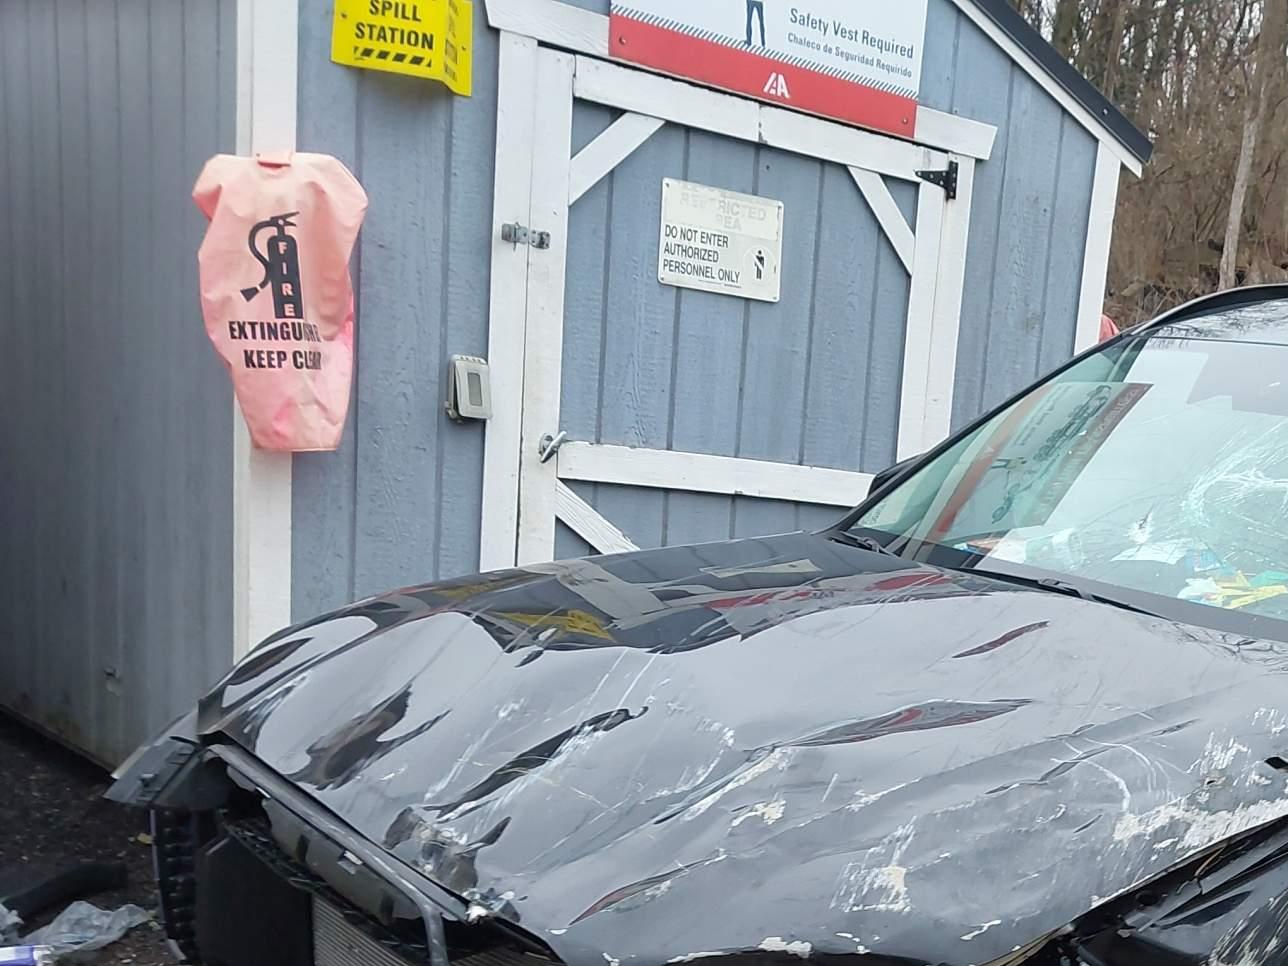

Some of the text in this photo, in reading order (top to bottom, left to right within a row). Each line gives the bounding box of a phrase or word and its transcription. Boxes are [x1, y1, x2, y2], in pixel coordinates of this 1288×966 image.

[369, 0, 422, 22] SPILL
[354, 22, 434, 50] STATION
[790, 8, 914, 59] Safety Vest Required
[787, 32, 821, 51] Chaleco
[822, 43, 833, 55] de
[835, 46, 875, 67] Seguridad
[680, 190, 767, 222] RERICTED
[664, 224, 729, 249] DO NOT ENTER
[663, 241, 719, 263] AUTHORIZED
[277, 241, 296, 317] FIRE
[663, 258, 716, 280] PERSONNEL
[717, 268, 741, 284] ONLY
[243, 349, 287, 369] KEEP
